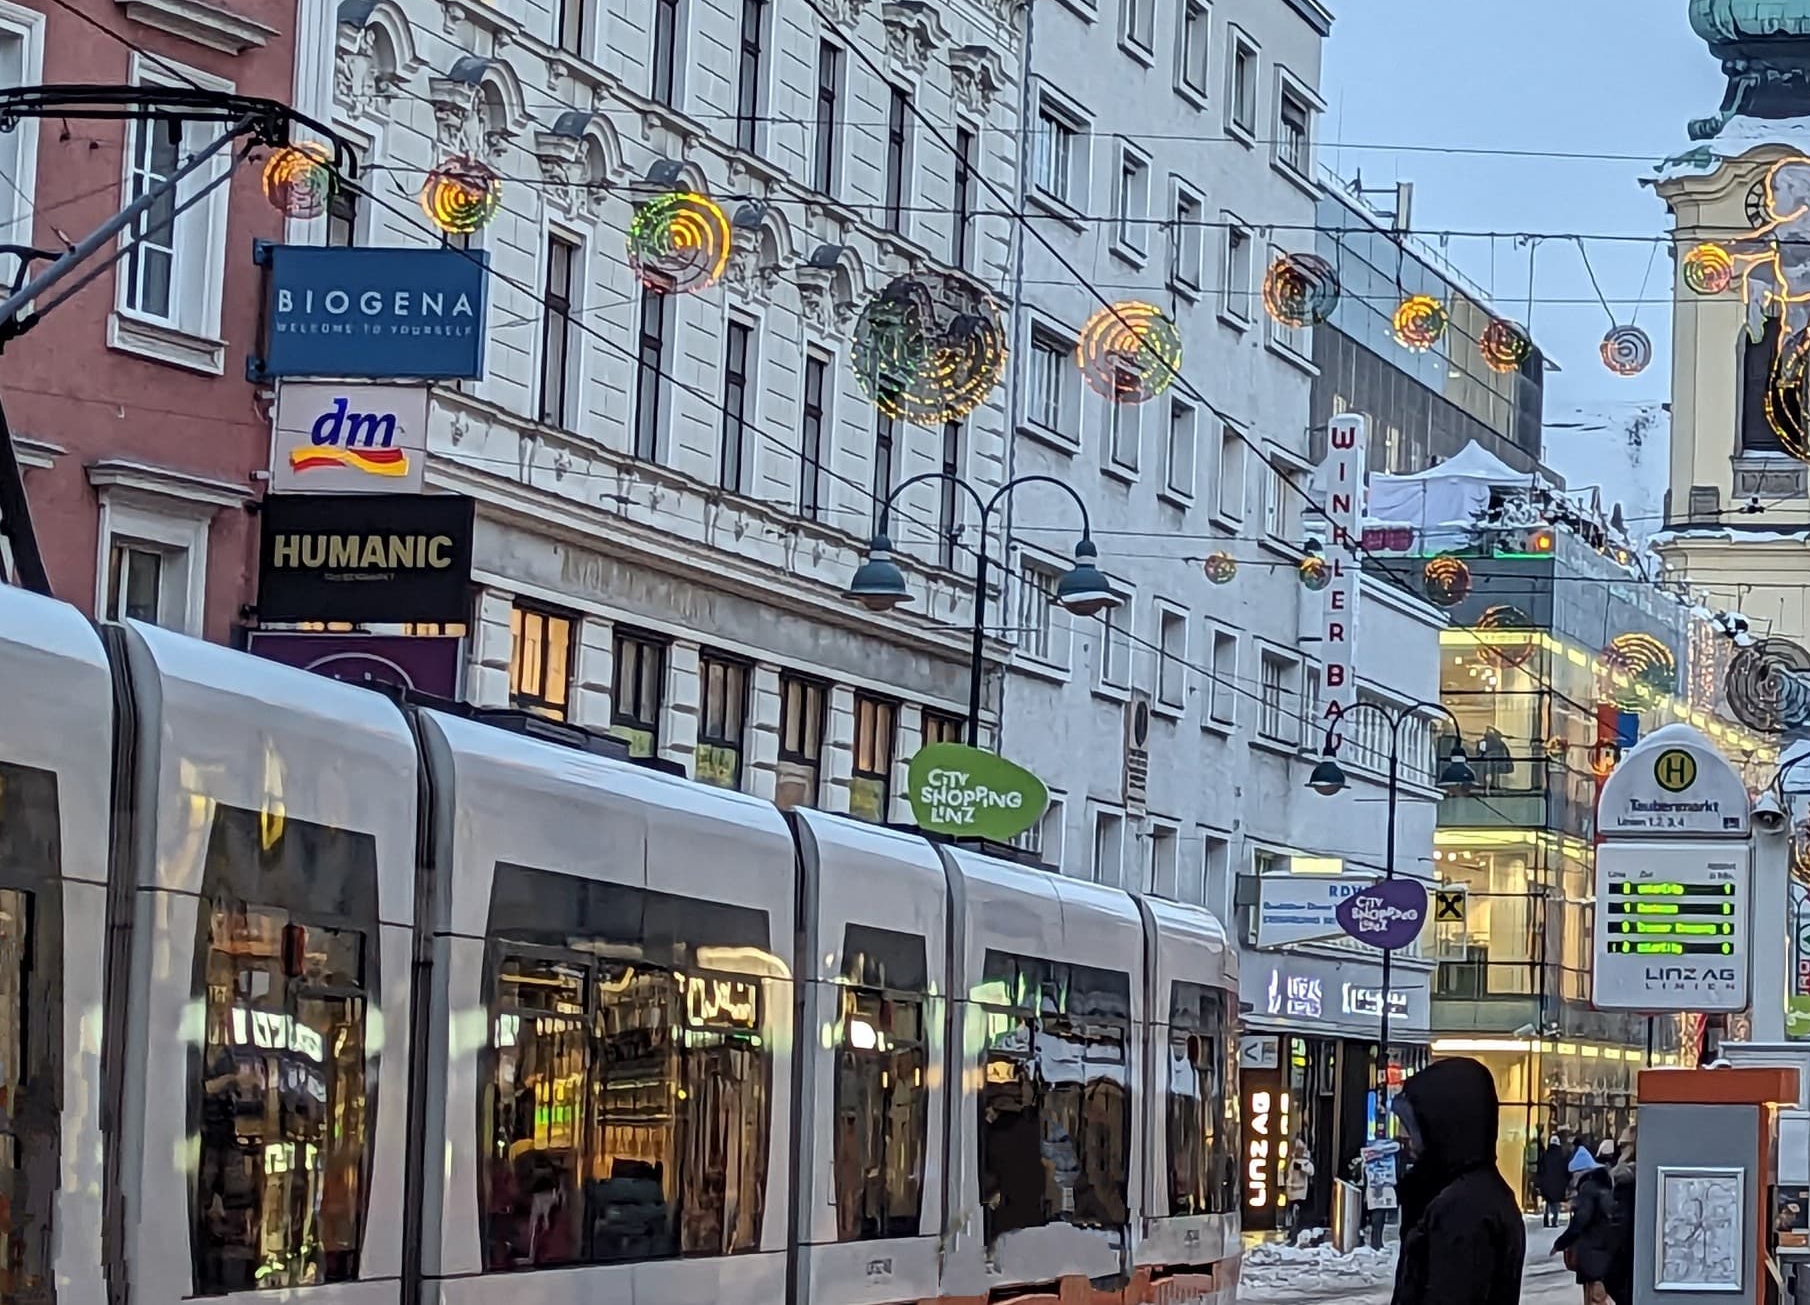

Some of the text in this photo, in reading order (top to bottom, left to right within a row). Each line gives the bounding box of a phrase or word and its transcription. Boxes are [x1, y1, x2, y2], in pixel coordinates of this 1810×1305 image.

[278, 289, 473, 317] BIOGENA
[311, 397, 397, 448] dm
[274, 534, 453, 569] HUMANIC
[927, 768, 970, 788] CITY
[920, 785, 1023, 808] SHOPPING
[930, 806, 976, 825] LINZ
[1646, 967, 1735, 981] LINZ AG
